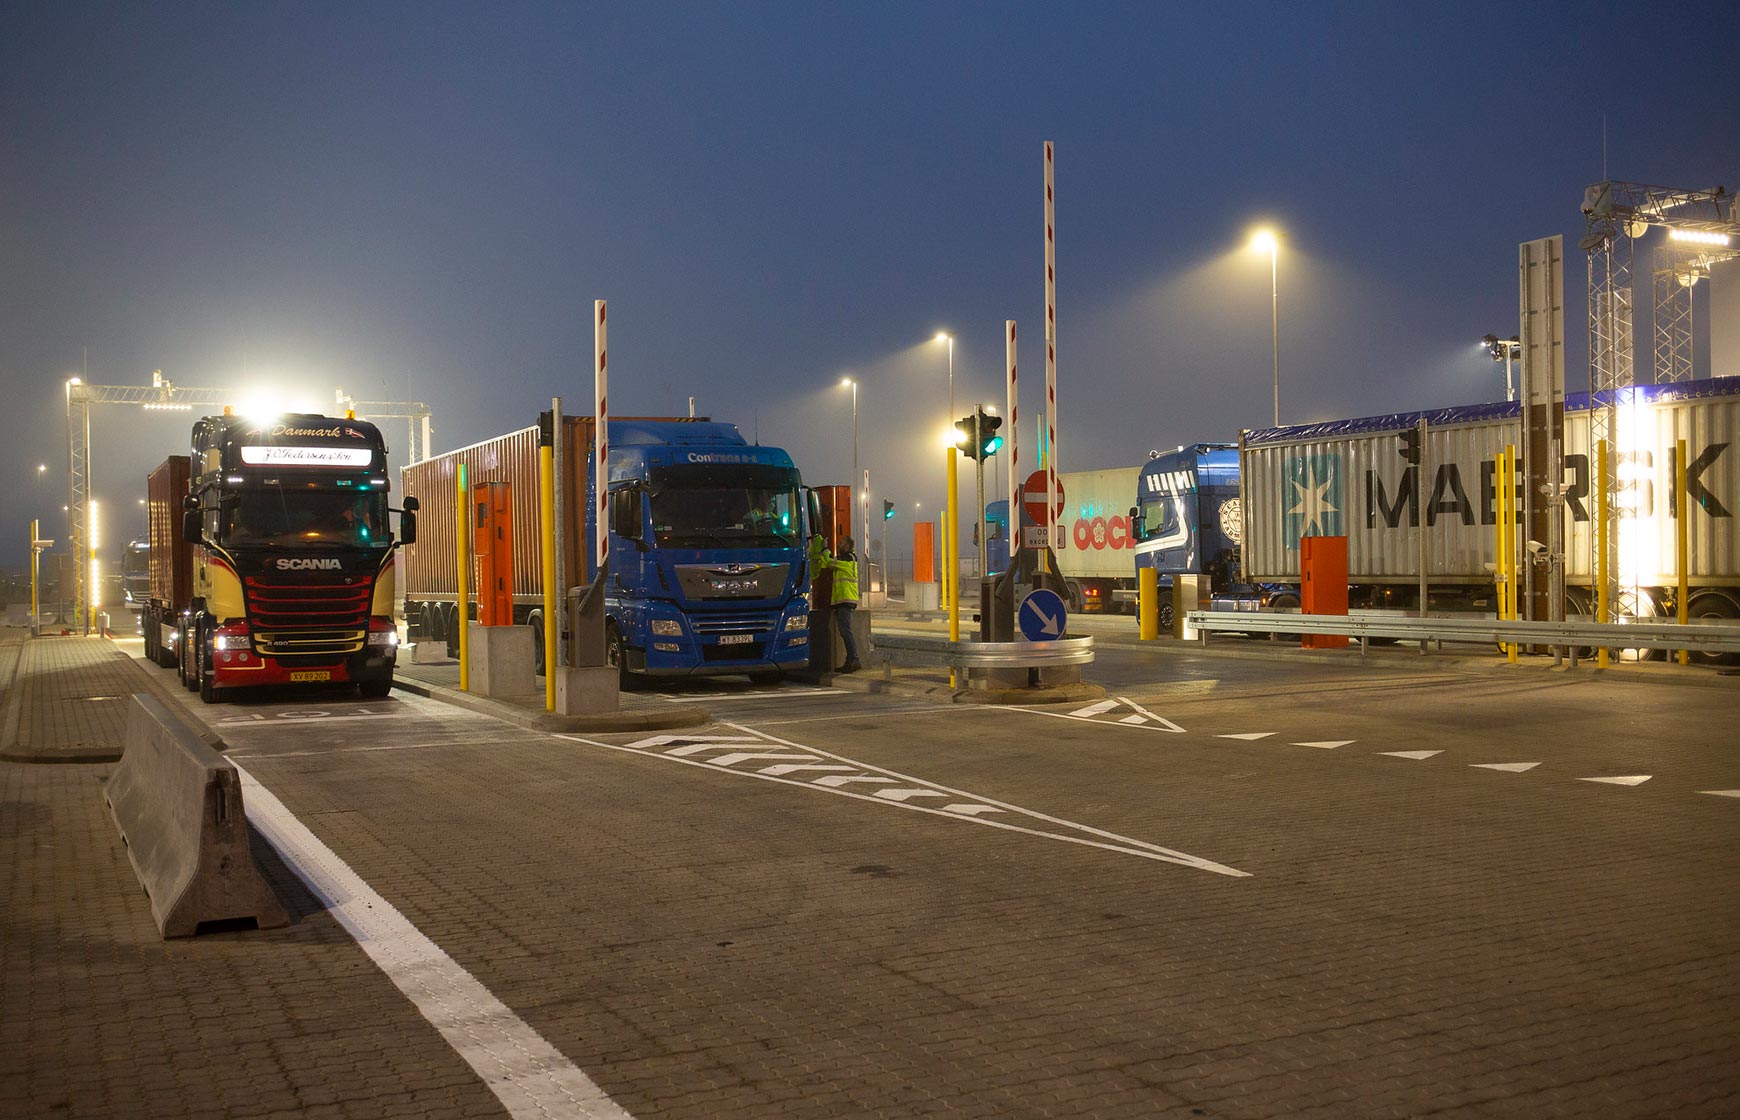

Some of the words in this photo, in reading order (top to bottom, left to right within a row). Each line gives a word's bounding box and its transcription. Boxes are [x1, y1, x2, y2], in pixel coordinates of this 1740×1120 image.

[271, 424, 341, 438] Danmark
[1073, 515, 1138, 551] OOCL
[276, 558, 342, 570] SCANIA
